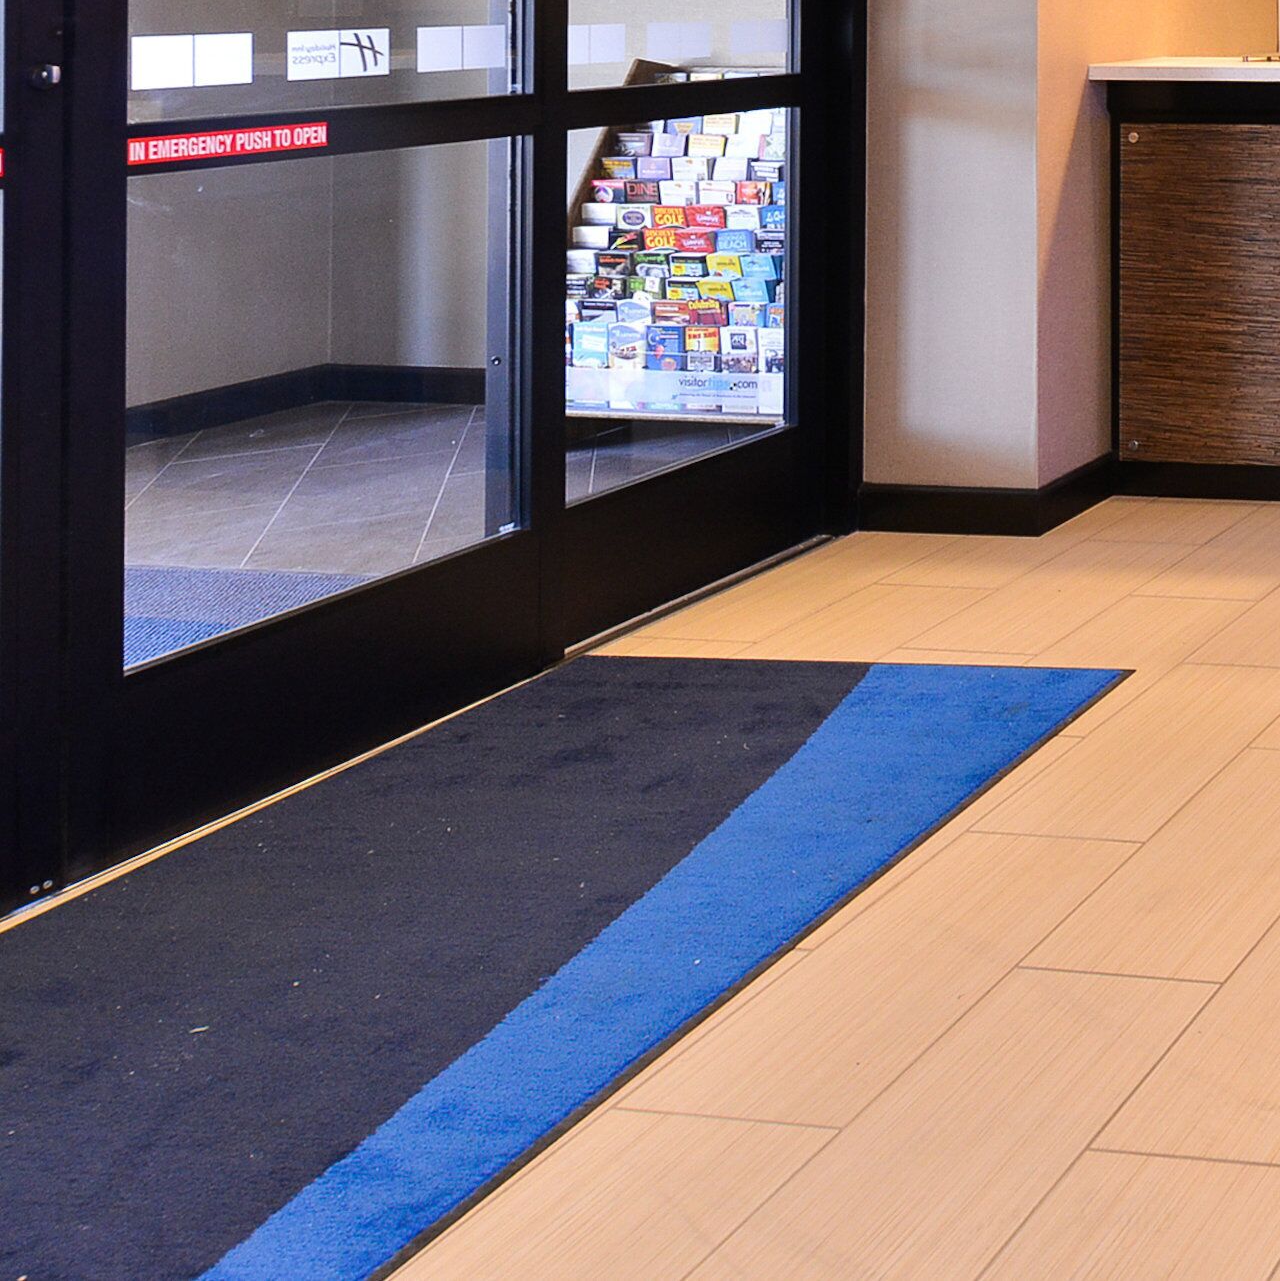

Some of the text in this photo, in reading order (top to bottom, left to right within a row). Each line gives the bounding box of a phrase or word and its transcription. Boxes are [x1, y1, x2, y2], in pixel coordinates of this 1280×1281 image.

[129, 125, 327, 161] IN EMERGENCY PUSH TO OPEN
[627, 183, 659, 196] DINE
[655, 214, 685, 225] GOLF
[646, 236, 677, 247] GOLF
